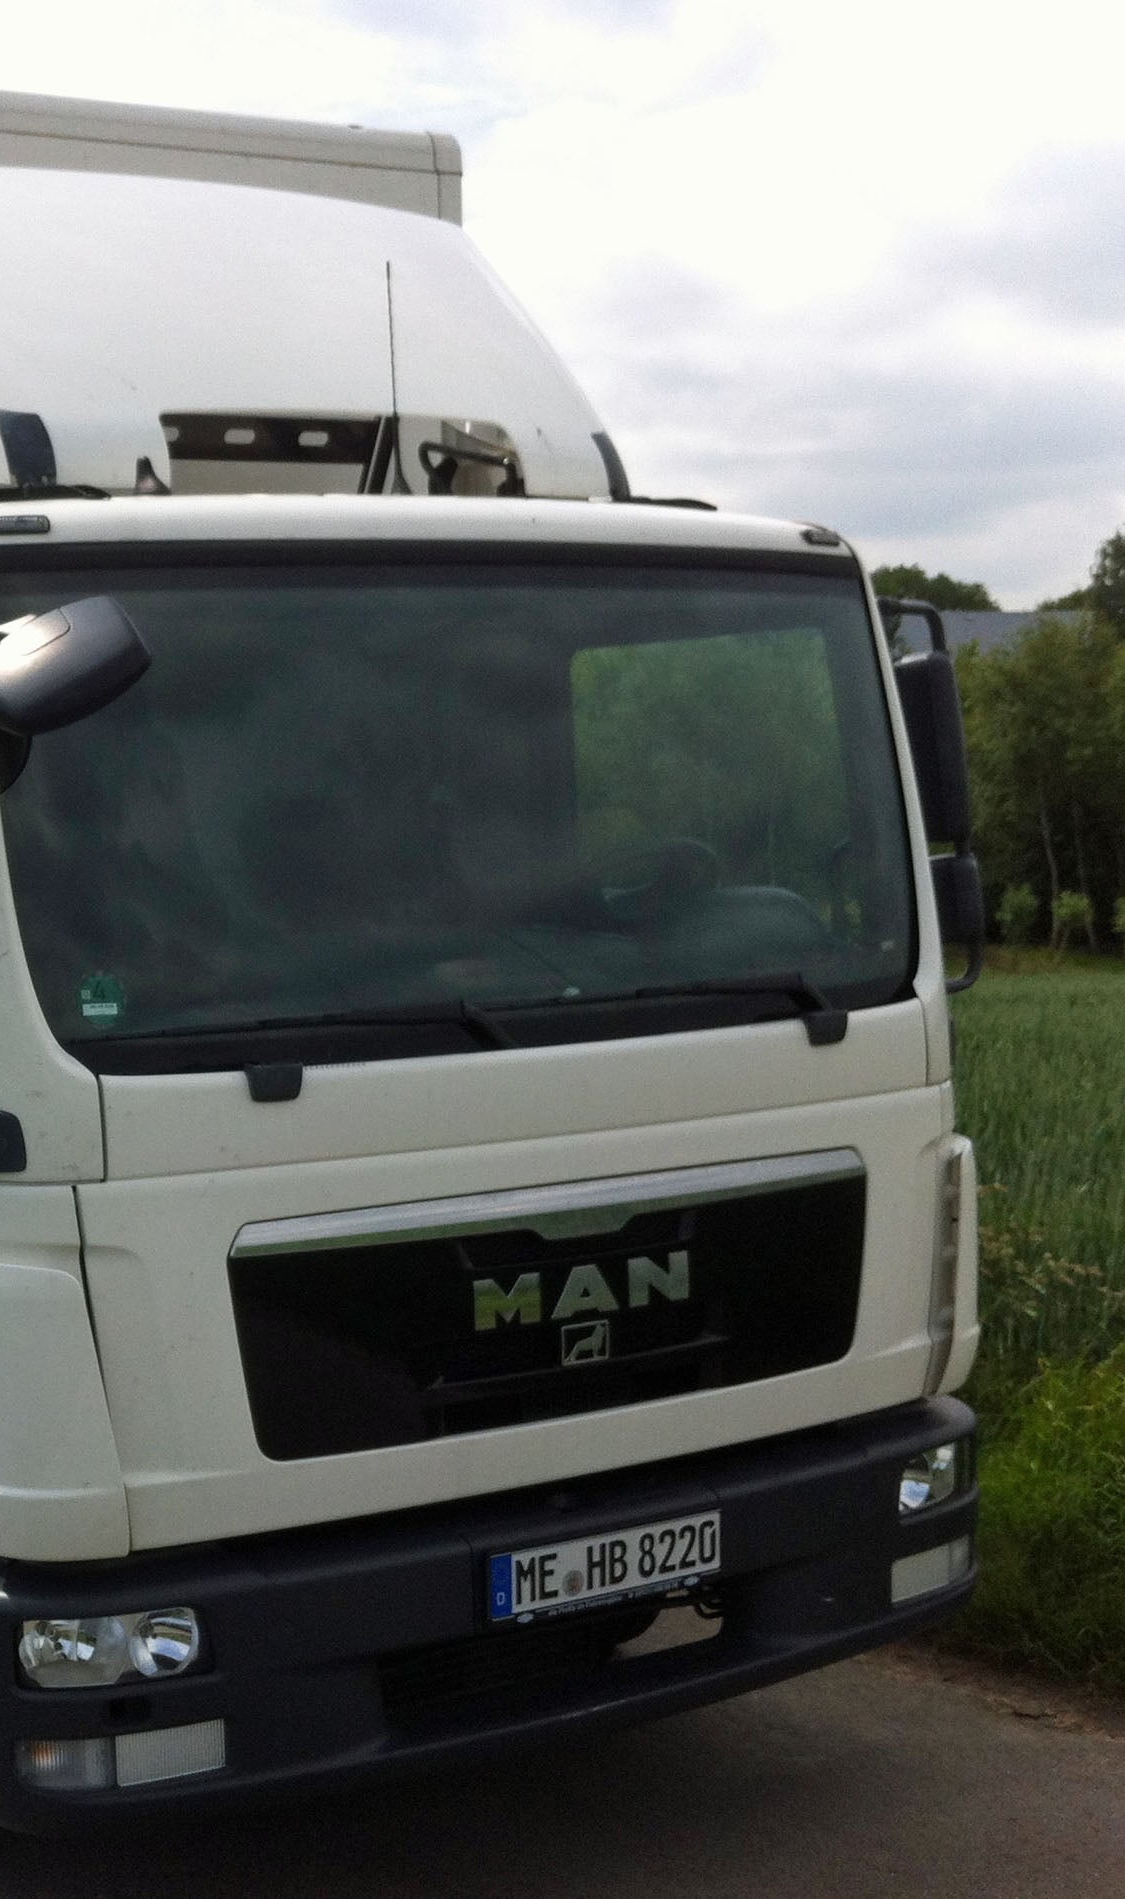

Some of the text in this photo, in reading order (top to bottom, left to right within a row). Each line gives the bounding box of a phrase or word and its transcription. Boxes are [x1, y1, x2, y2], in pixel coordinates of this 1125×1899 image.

[93, 981, 106, 1000] 4
[472, 1250, 690, 1331] MAN
[515, 1553, 559, 1605] ME
[586, 1540, 627, 1590] HB
[638, 1519, 717, 1578] 8220
